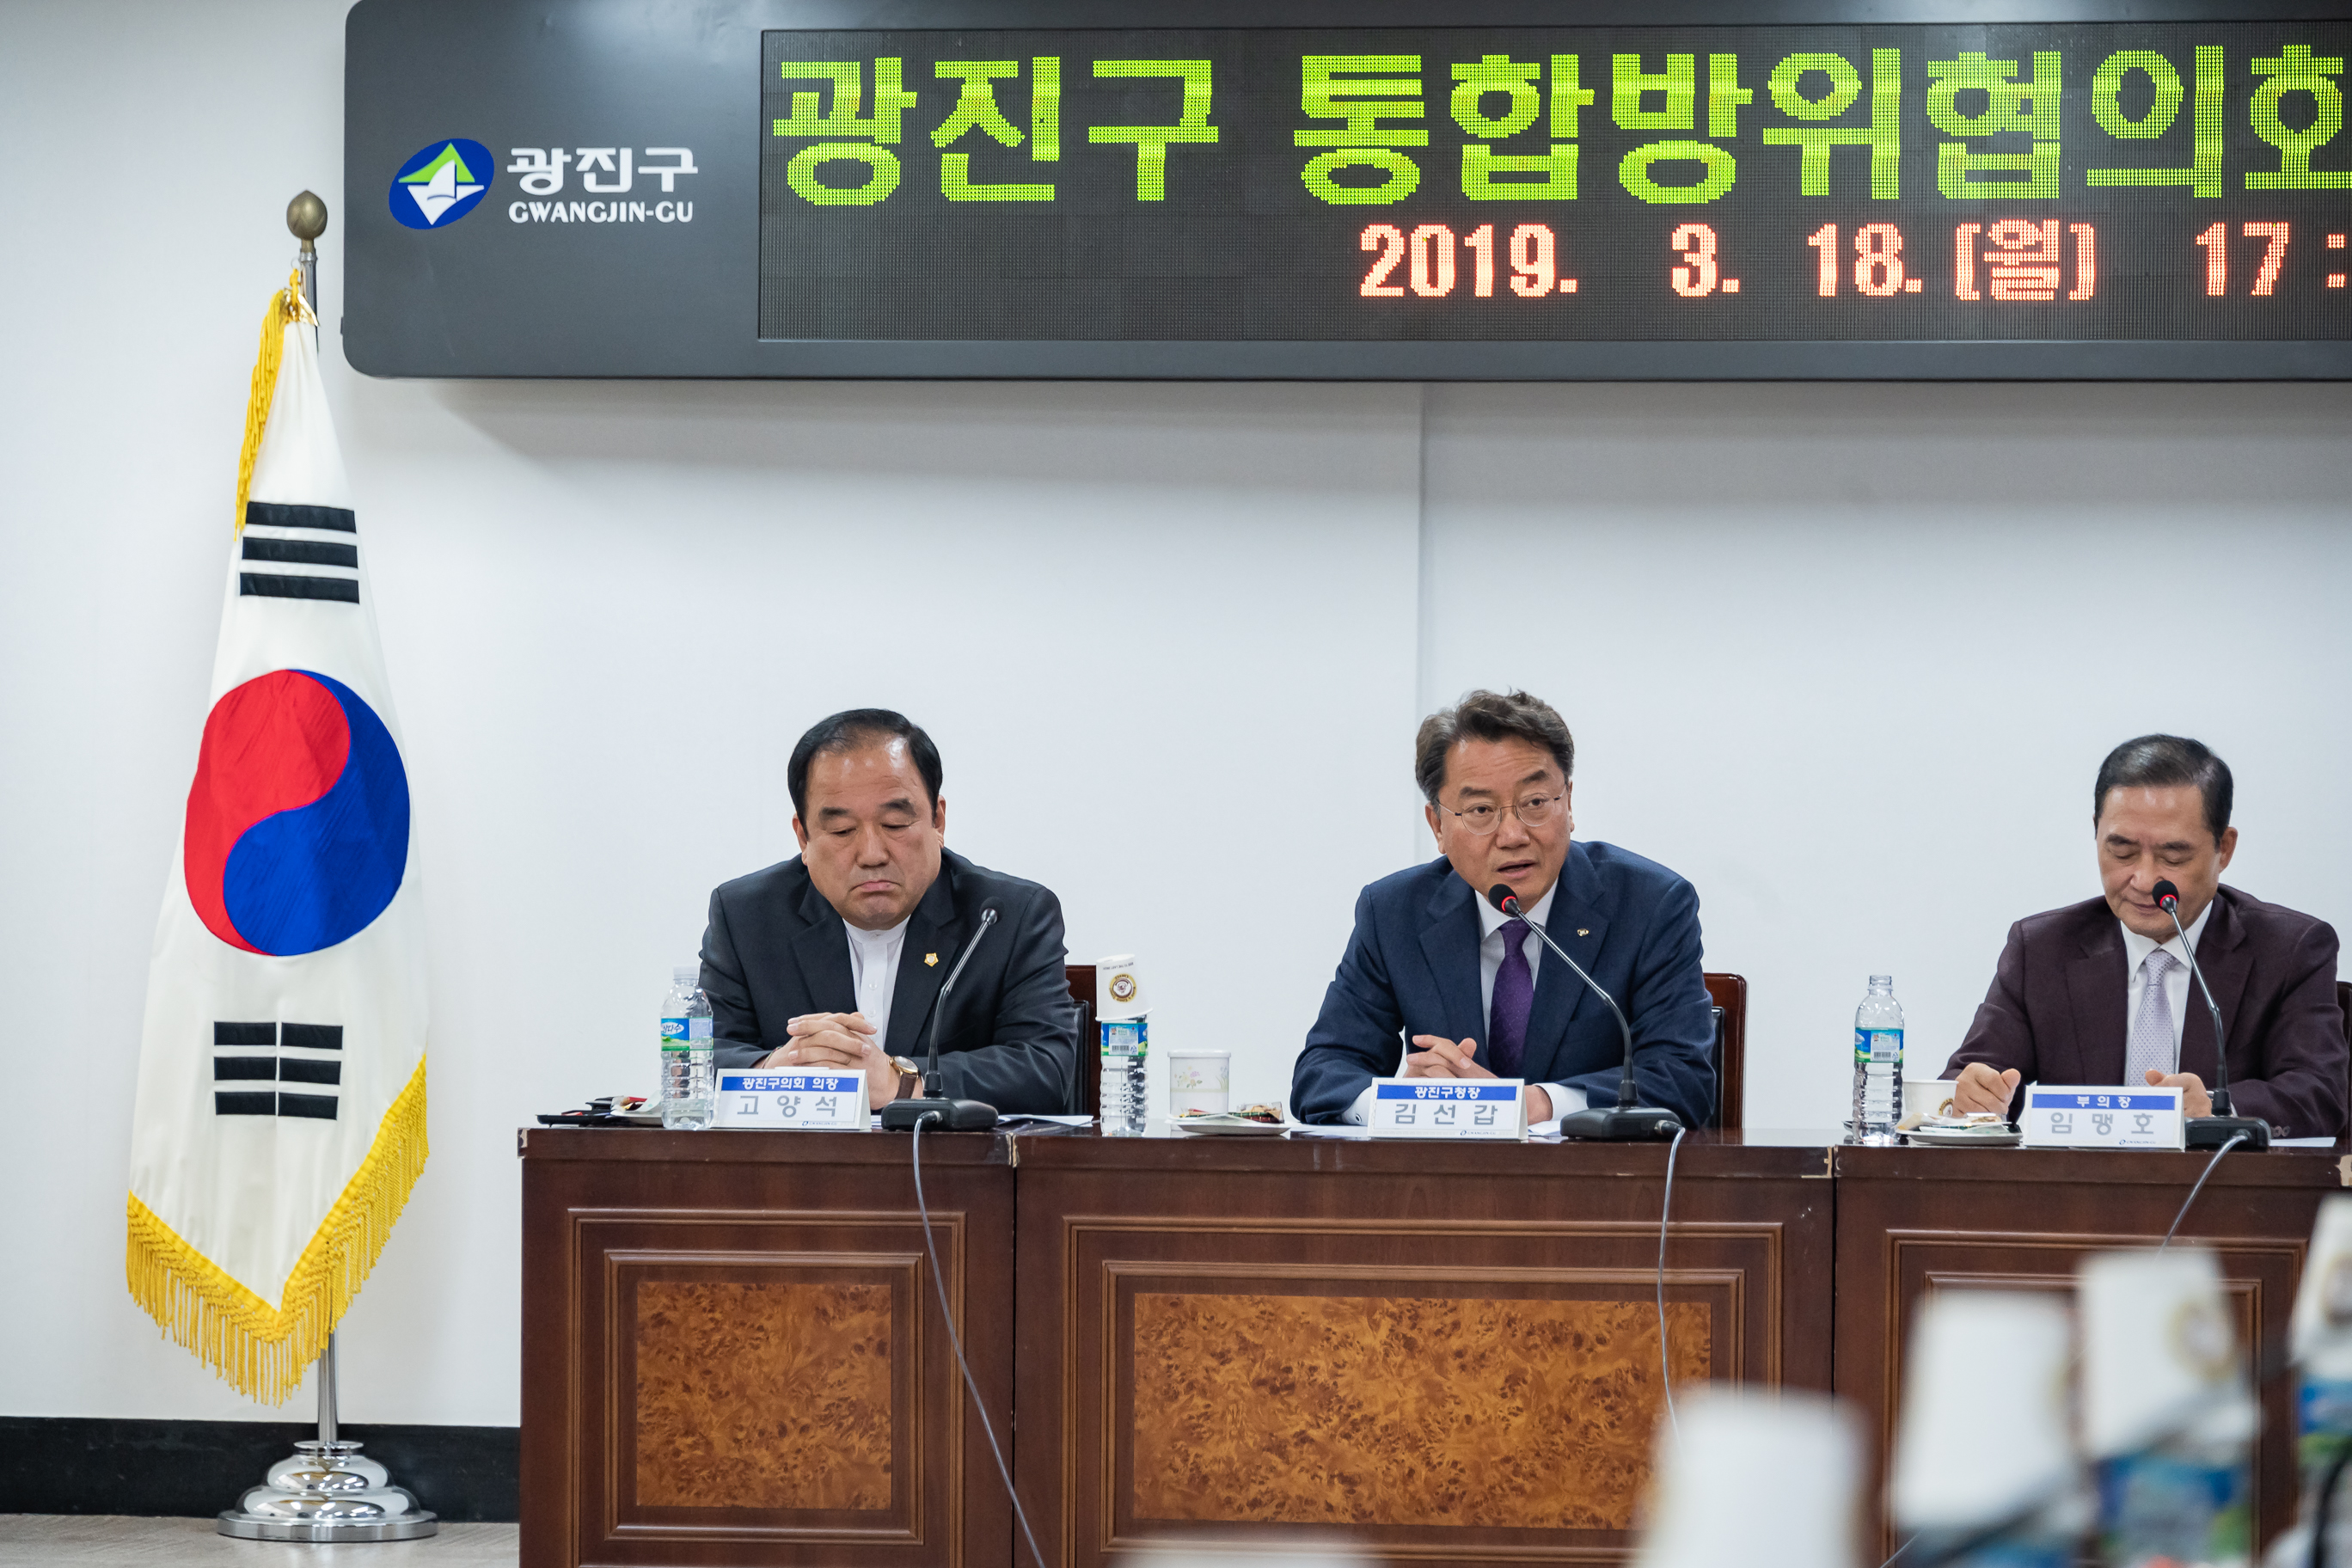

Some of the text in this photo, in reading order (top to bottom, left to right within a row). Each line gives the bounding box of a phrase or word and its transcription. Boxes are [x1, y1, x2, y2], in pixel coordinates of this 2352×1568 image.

[772, 56, 1219, 206] 광진구
[506, 147, 699, 196] 광진구
[508, 200, 694, 224] GWANGJIN-GU
[1359, 223, 1578, 297] 2019.
[1671, 224, 1740, 297] 3.
[742, 1077, 839, 1091] 광진구의회 의장
[1414, 1086, 1481, 1100] 광진구청장
